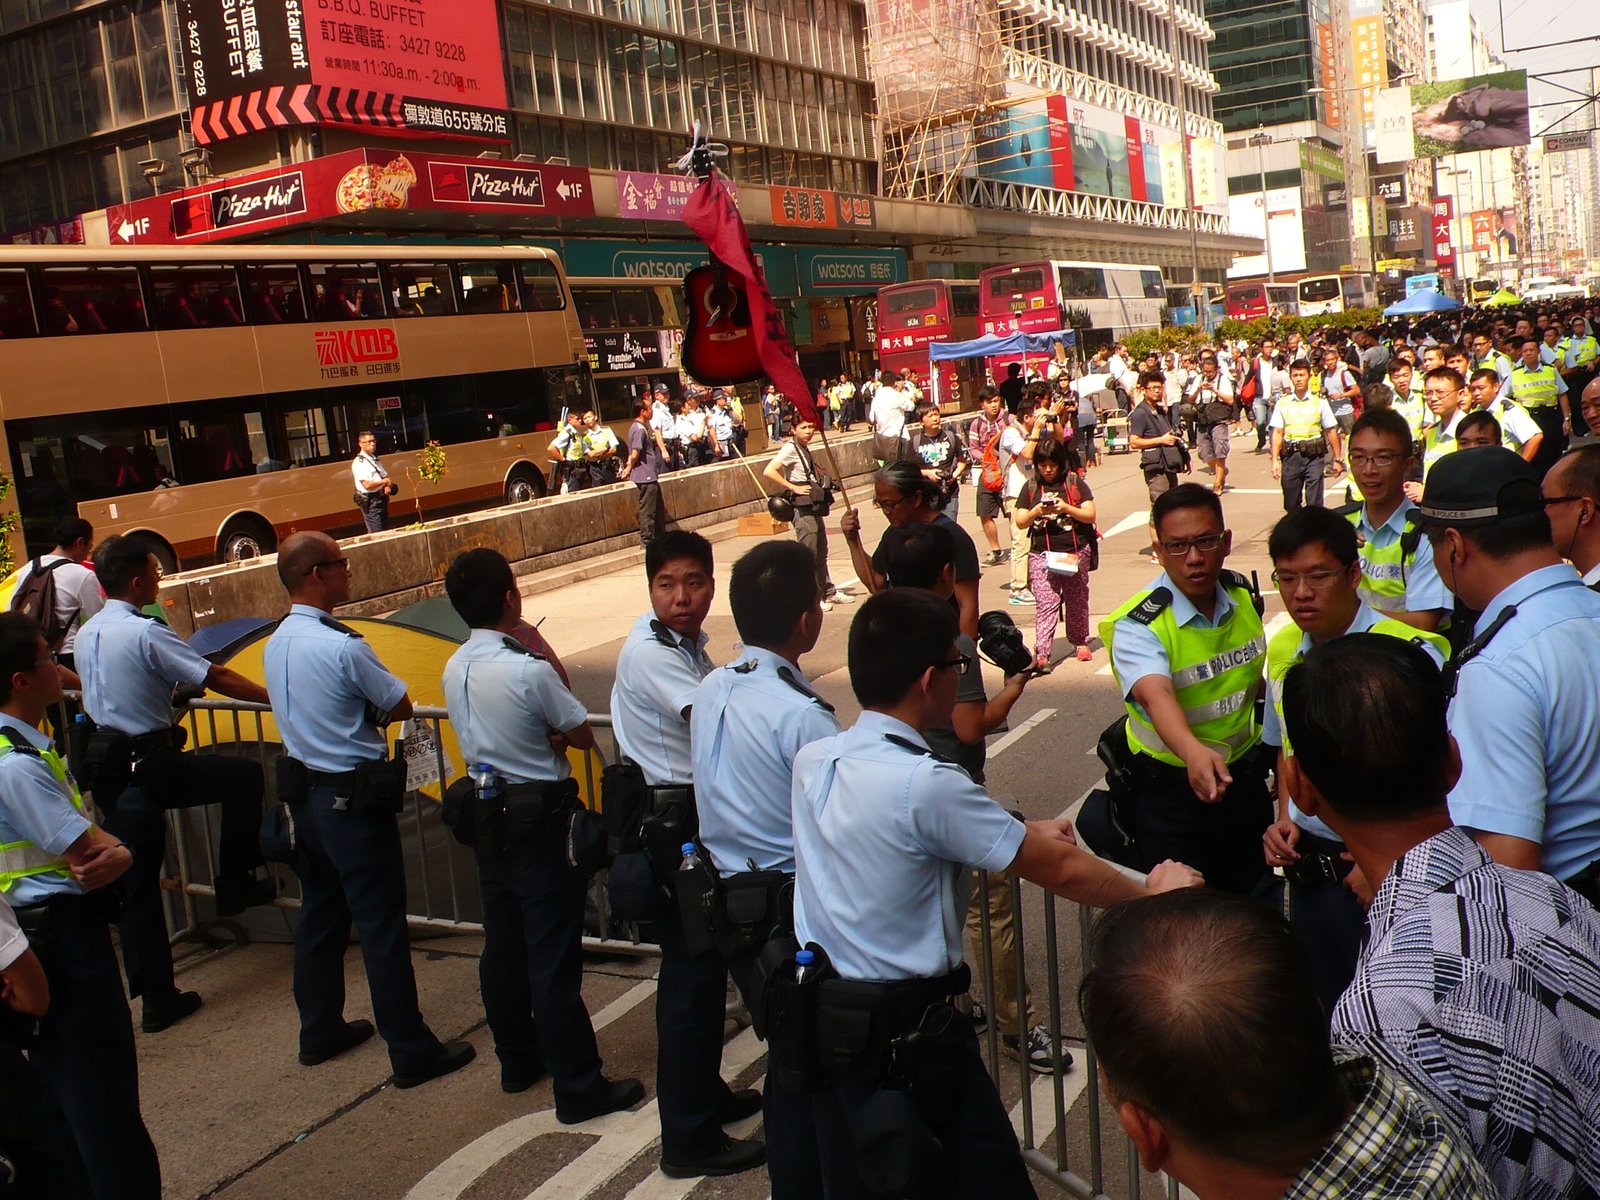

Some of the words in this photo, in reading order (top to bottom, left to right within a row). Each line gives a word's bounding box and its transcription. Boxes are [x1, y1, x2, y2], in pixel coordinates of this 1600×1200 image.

[370, 1, 425, 27] BUFFET
[188, 20, 202, 56] 3427
[222, 0, 246, 78] BUFFET
[400, 35, 430, 55] 3427
[435, 41, 466, 62] 9228
[193, 60, 207, 96] 9228
[363, 58, 422, 83] 11:30a.m.
[404, 103, 507, 134] 彌敦道655號分店
[471, 172, 511, 197] Pizza
[511, 176, 539, 197] Hut
[570, 183, 583, 198] 1F
[217, 194, 263, 223] Pizza
[263, 184, 300, 210] Hut
[135, 218, 150, 236] 1F
[1434, 203, 1451, 256] 周大福
[817, 263, 865, 279] watsons
[881, 335, 913, 350] 周大福
[320, 365, 359, 379] 九巴服務
[366, 362, 401, 376] 日日進步
